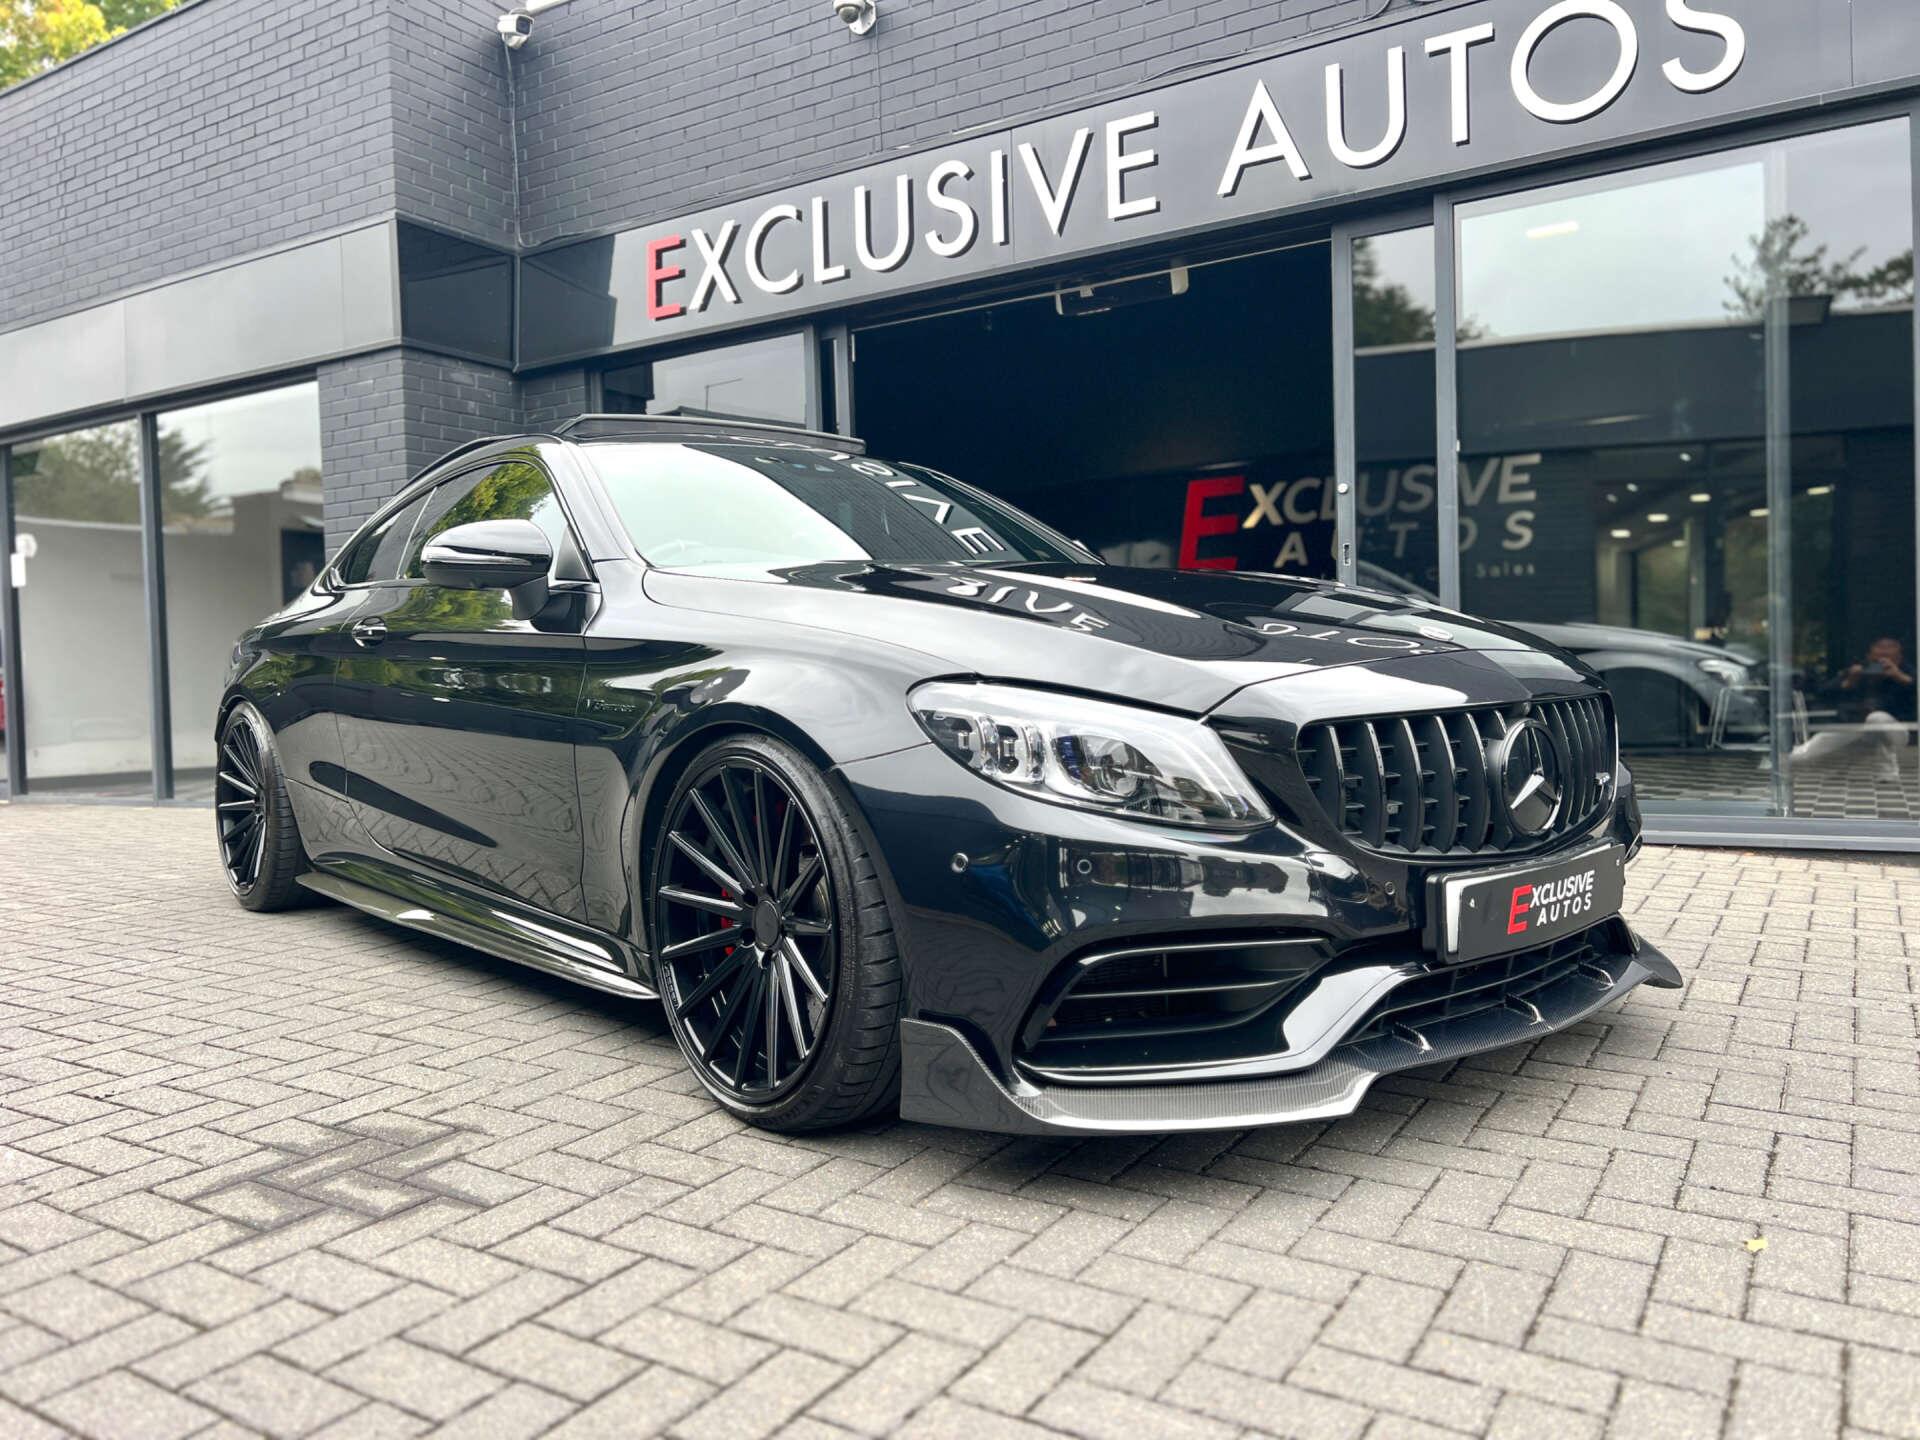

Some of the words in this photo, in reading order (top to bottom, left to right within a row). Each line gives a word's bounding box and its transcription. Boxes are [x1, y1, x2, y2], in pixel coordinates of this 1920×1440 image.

[645, 111, 1160, 320] EXCLUSIVE
[1216, 0, 1746, 197] AUTOS
[1178, 453, 1541, 571] EXCLUSVE
[1274, 511, 1535, 568] ATOS
[1507, 870, 1596, 935] EXCLUSIVE
[1536, 892, 1593, 927] AUTOS
